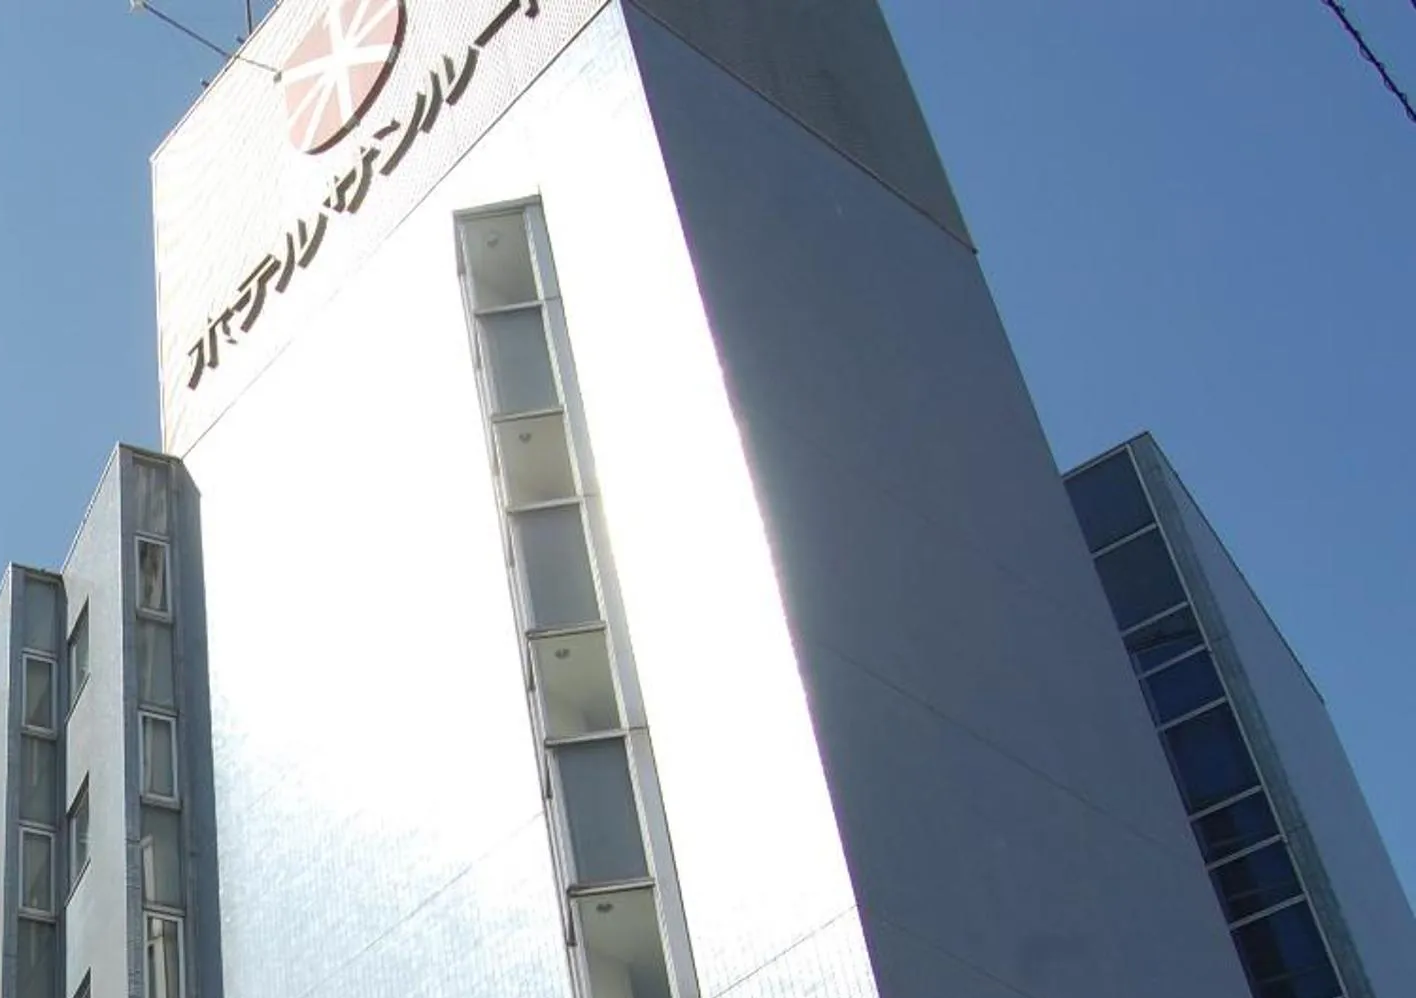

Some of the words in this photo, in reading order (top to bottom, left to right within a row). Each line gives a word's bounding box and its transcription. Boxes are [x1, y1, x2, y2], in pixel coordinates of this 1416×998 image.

[187, 0, 540, 389] ホテルサンルー
